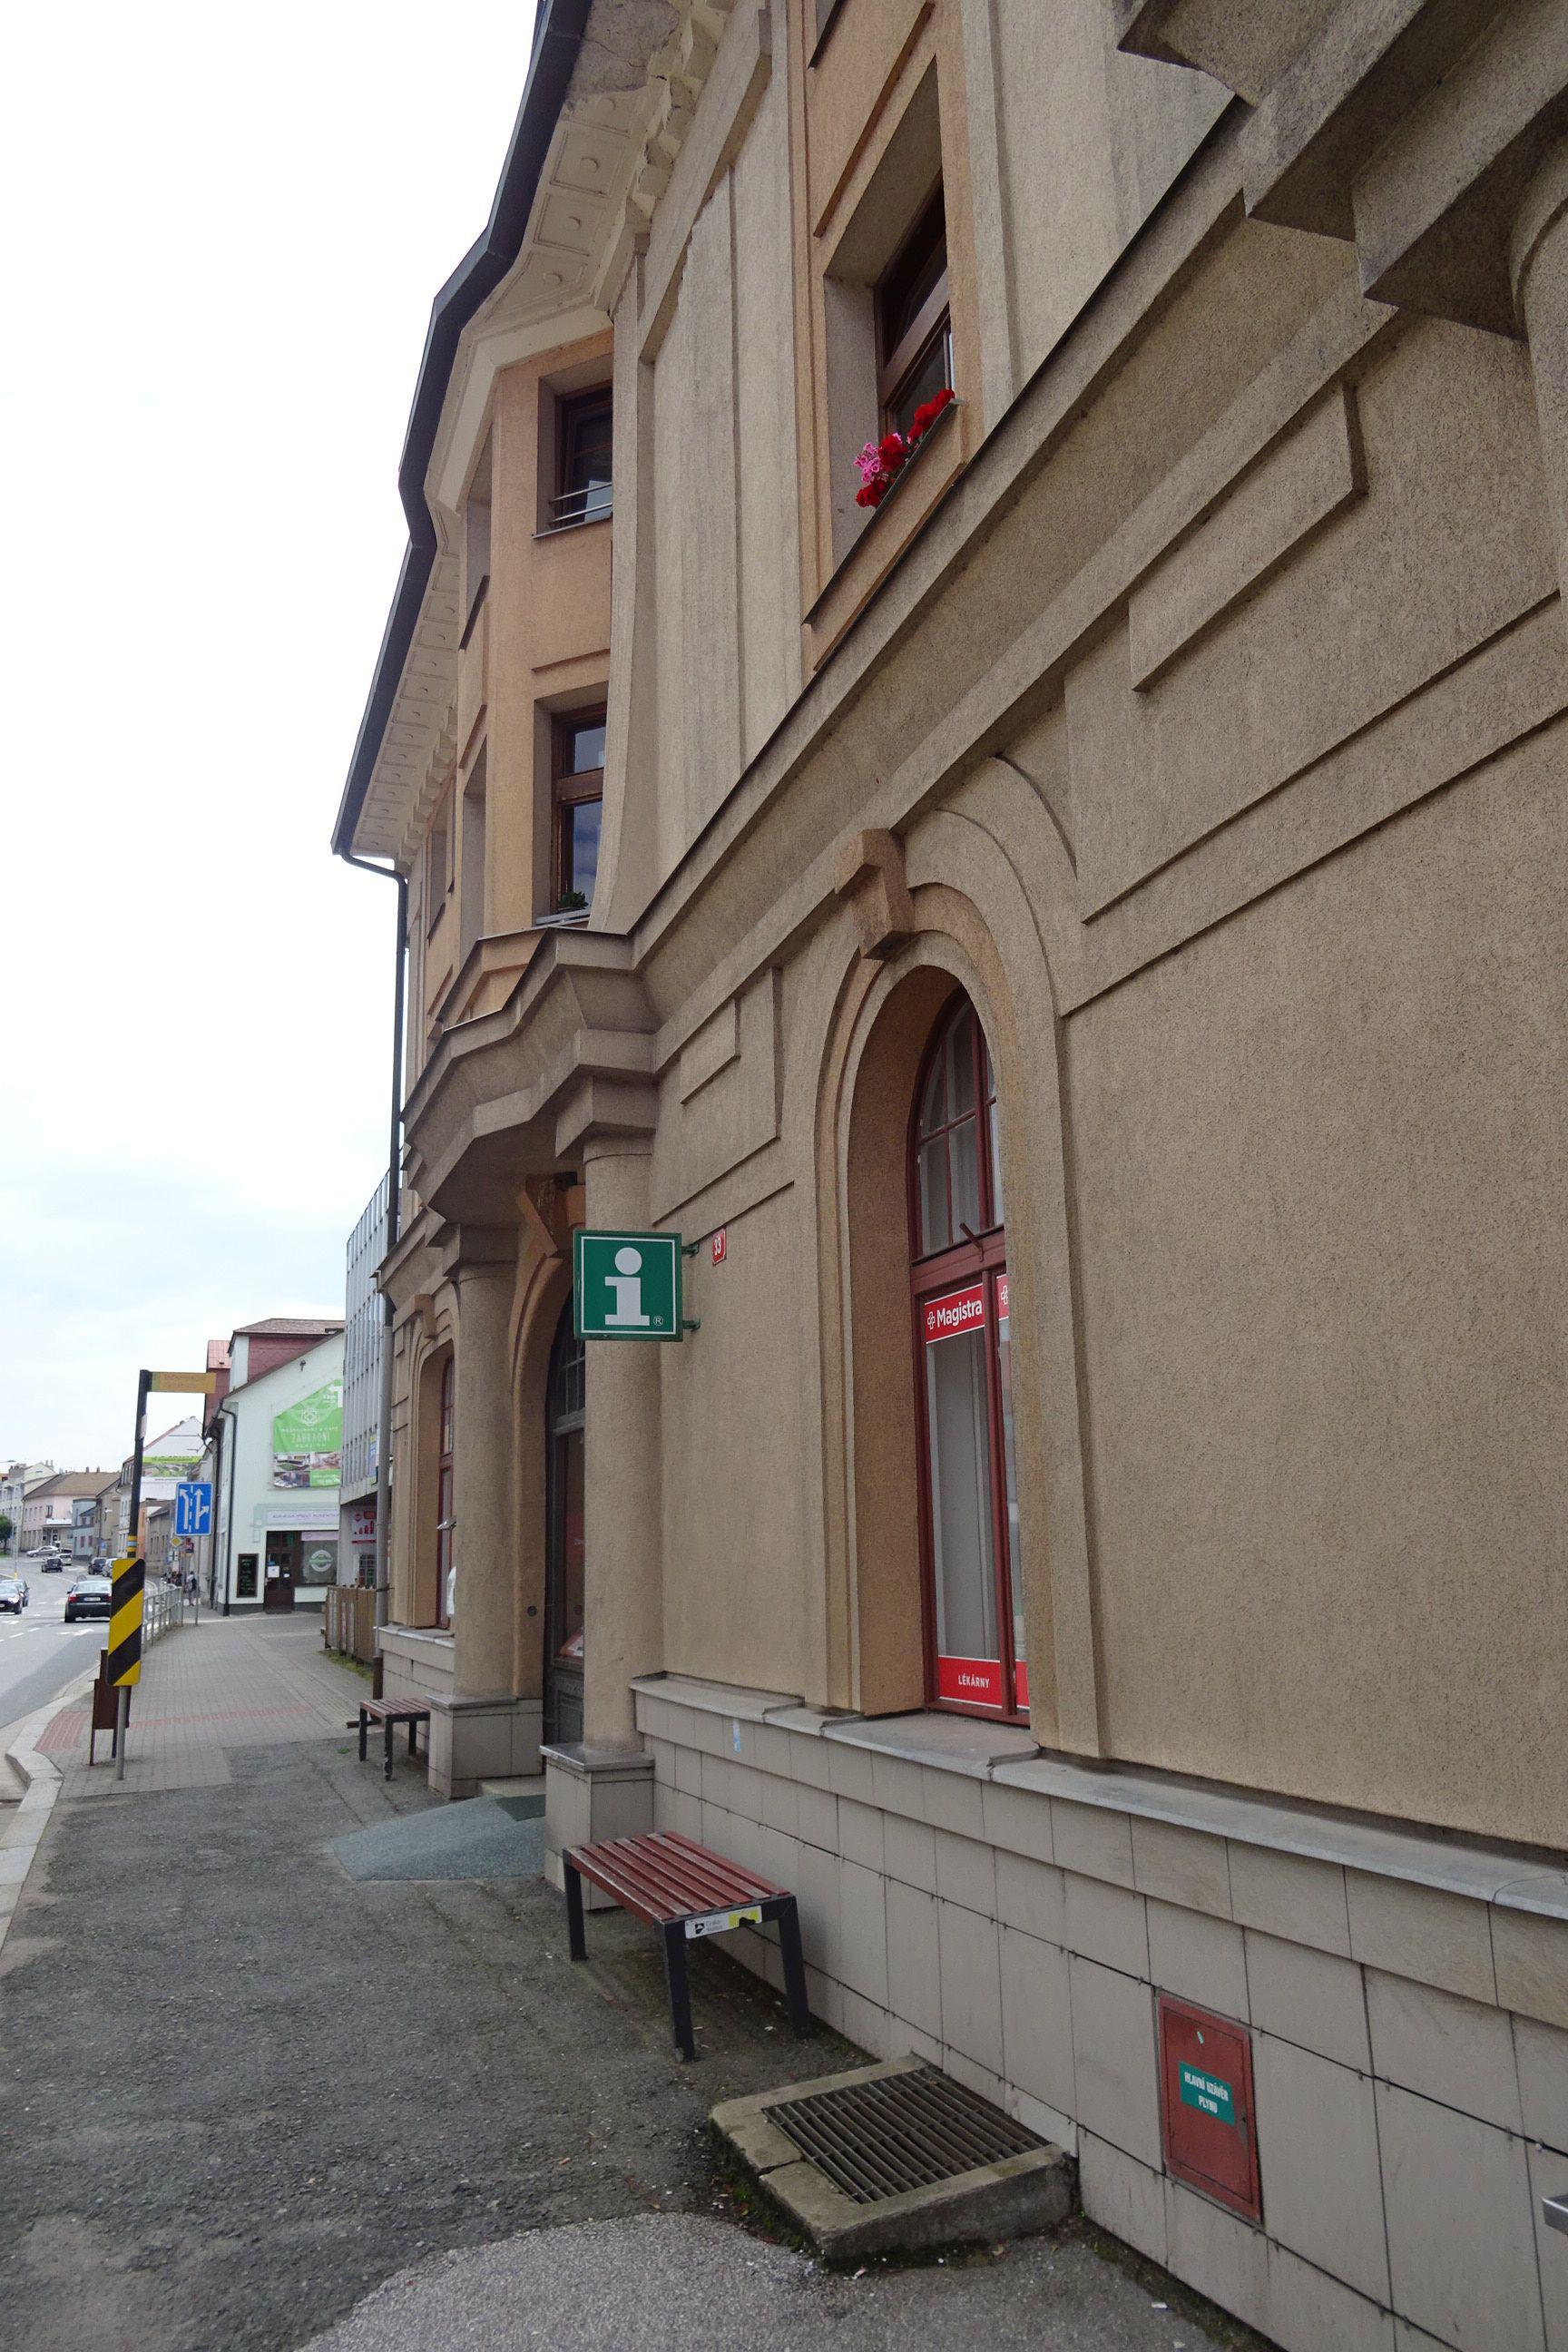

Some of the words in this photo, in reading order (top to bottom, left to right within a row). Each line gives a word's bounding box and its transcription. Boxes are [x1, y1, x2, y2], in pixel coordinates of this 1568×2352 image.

[936, 1300, 982, 1327] Magistra
[958, 1673, 989, 1688] LÉKÁRNY
[1198, 2094, 1218, 2113] PLYNU
